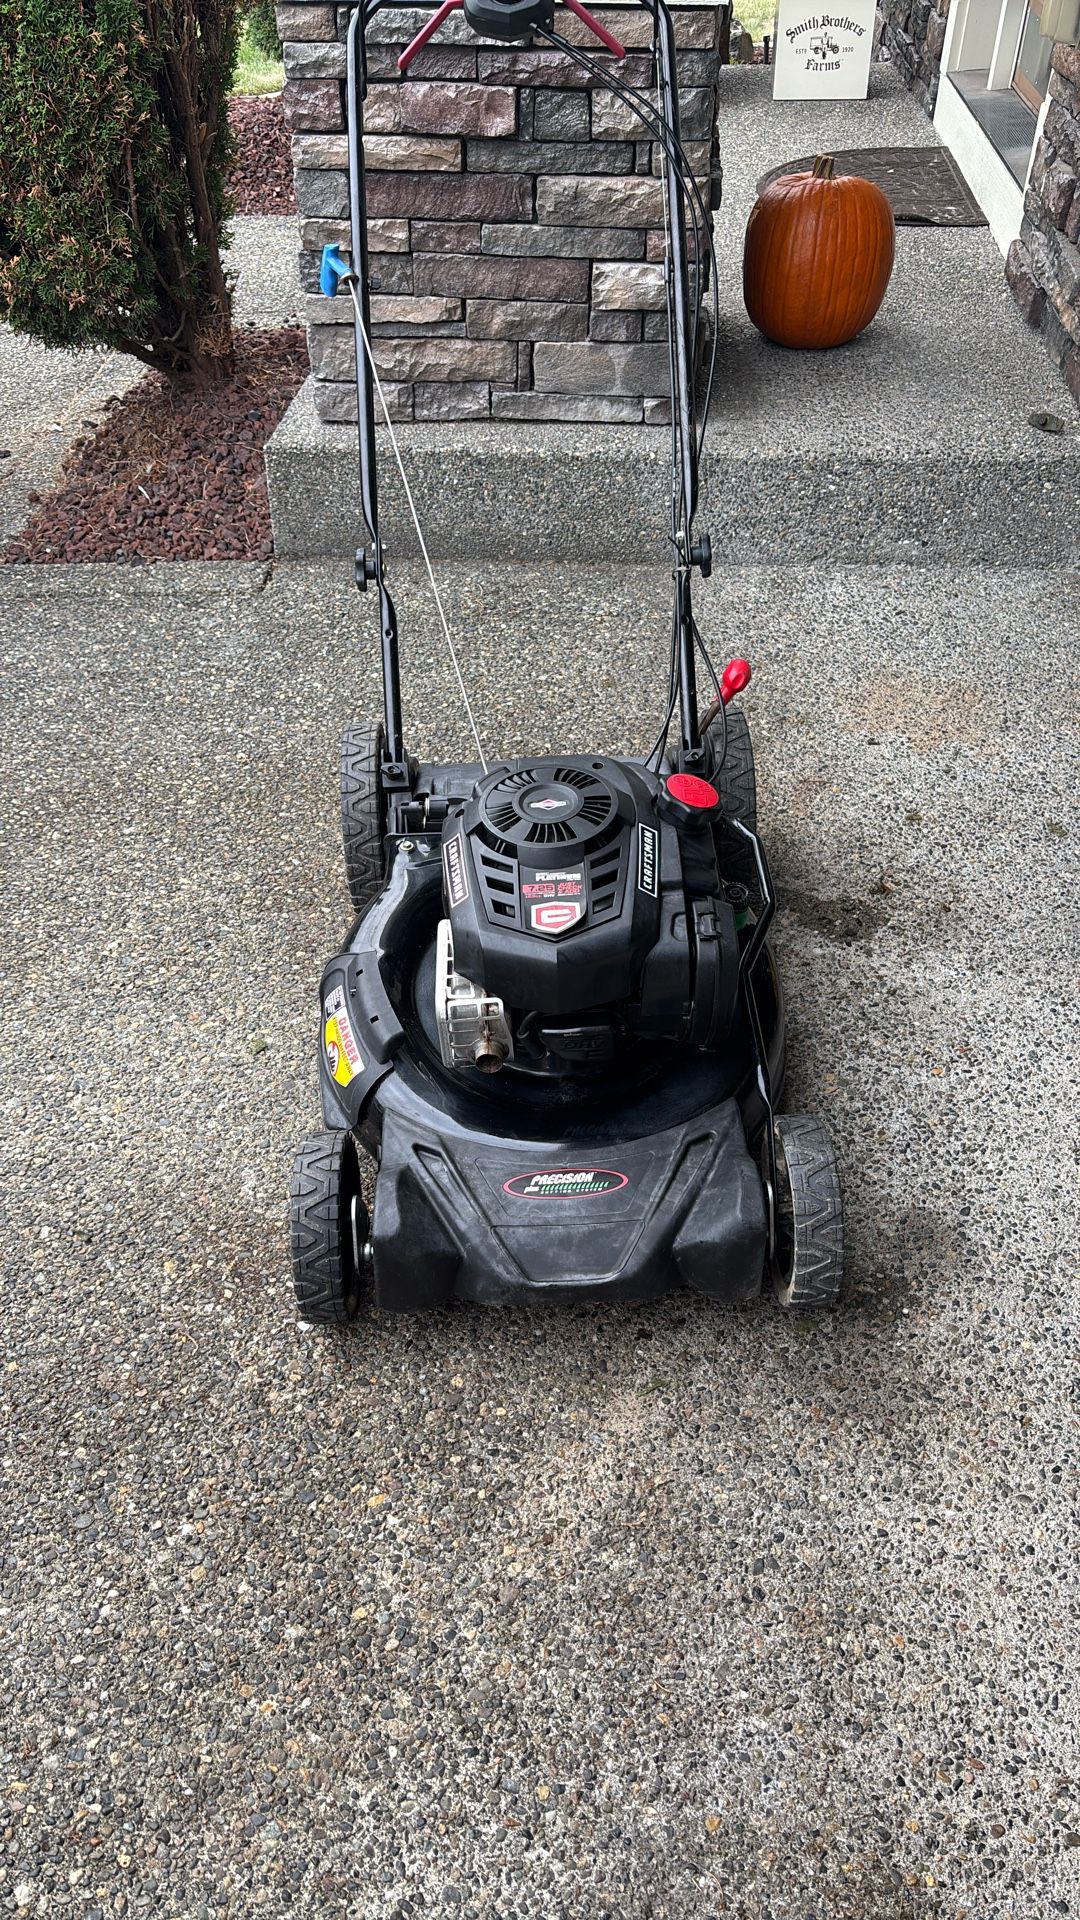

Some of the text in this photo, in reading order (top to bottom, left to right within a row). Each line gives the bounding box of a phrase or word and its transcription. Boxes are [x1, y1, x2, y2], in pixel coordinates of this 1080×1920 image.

[785, 15, 866, 44] Smith Brothers
[804, 59, 841, 71] Farms
[448, 841, 464, 900] CRAFTSMAN
[643, 830, 653, 890] CRAFTSMAN
[528, 884, 554, 892] 7.25
[338, 1017, 359, 1065] DANGER
[530, 1172, 594, 1186] PRECISION
